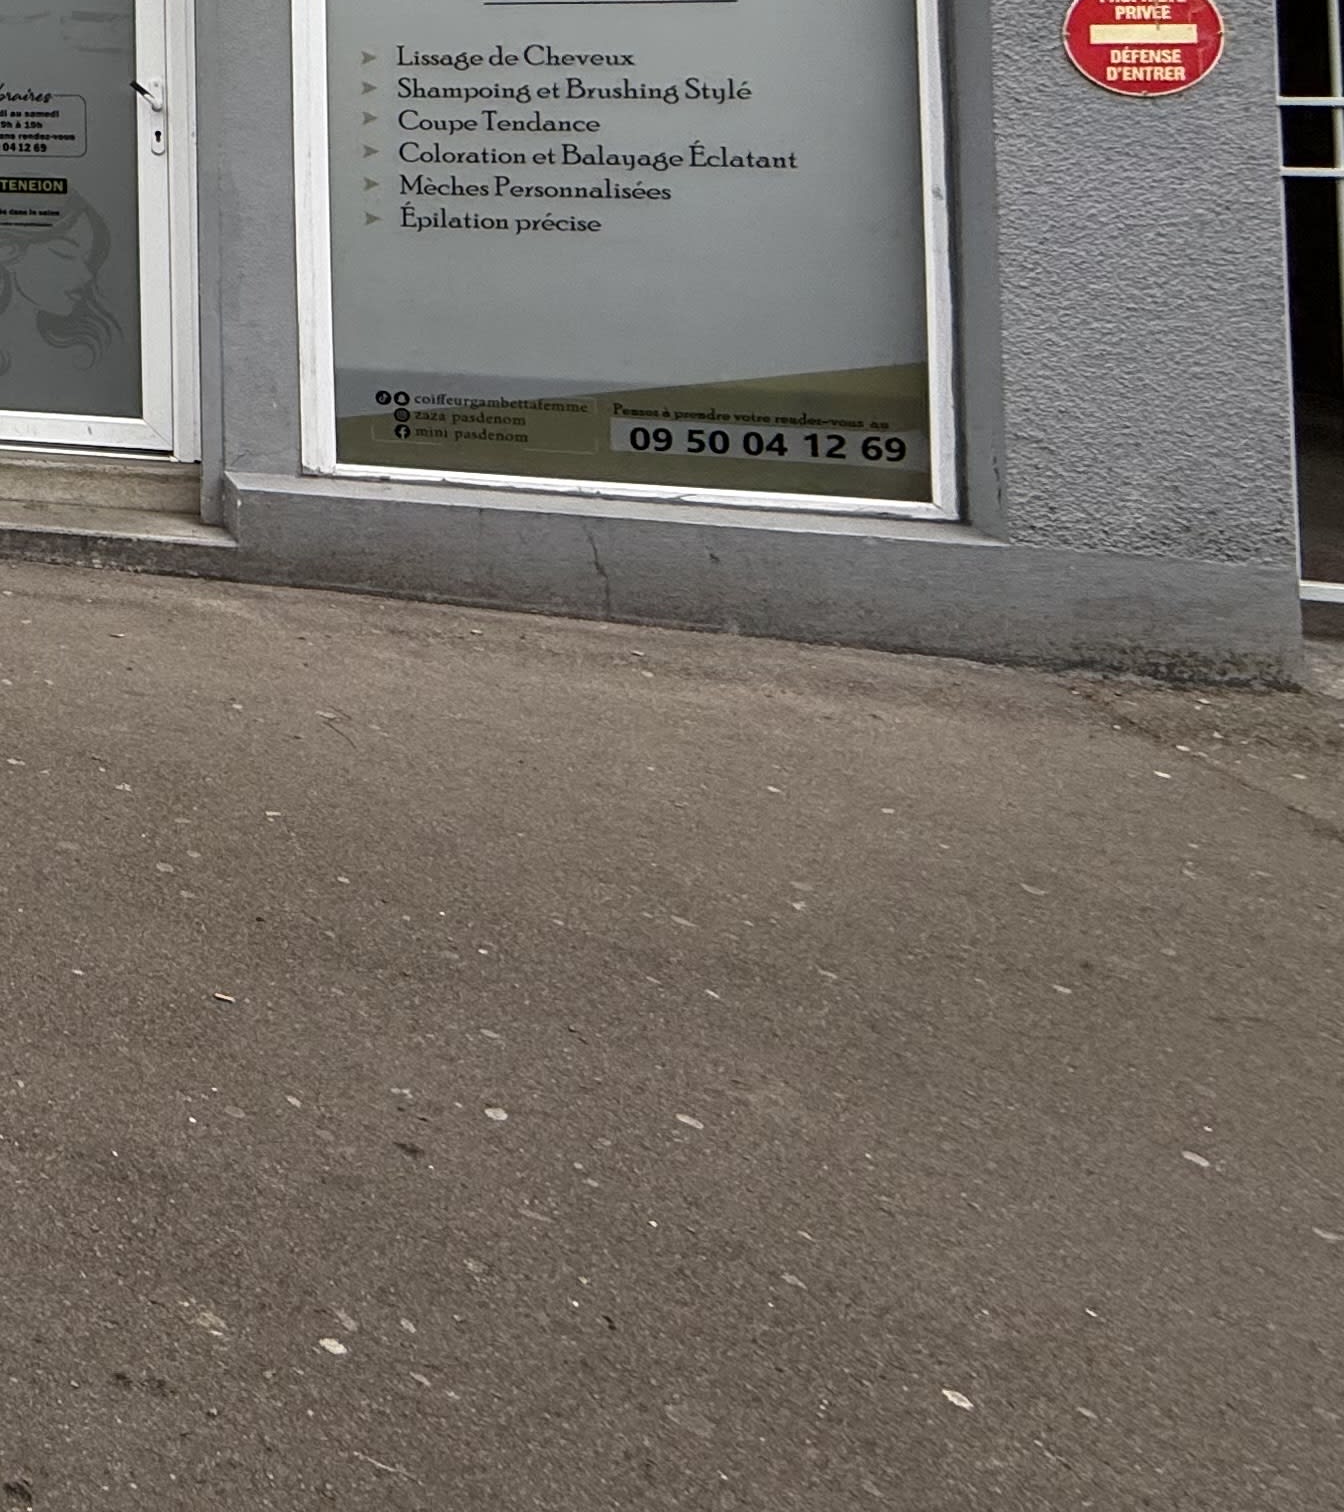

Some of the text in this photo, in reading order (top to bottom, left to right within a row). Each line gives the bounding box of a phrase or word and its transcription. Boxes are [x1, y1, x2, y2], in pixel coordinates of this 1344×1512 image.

[397, 44, 635, 71] Lissage de Cheveux
[1110, 46, 1182, 64] DÉFENSE
[1106, 66, 1187, 81] D'ENTRER
[397, 77, 752, 104] Shampoing et Brushing Stylé
[398, 109, 600, 135] Coupe Tendance
[2, 142, 16, 152] 04
[18, 143, 31, 152] 12
[399, 140, 799, 171] Coloration et Balayage Éclatant
[399, 174, 672, 200] Mèches Personnalisées
[400, 201, 602, 235] Épilation précise
[414, 393, 589, 414] coiffeurgambettafemme
[415, 410, 526, 427] zaza pasdenom
[454, 428, 529, 443] pasdenom
[629, 426, 907, 462] 09 50 04 12 69
